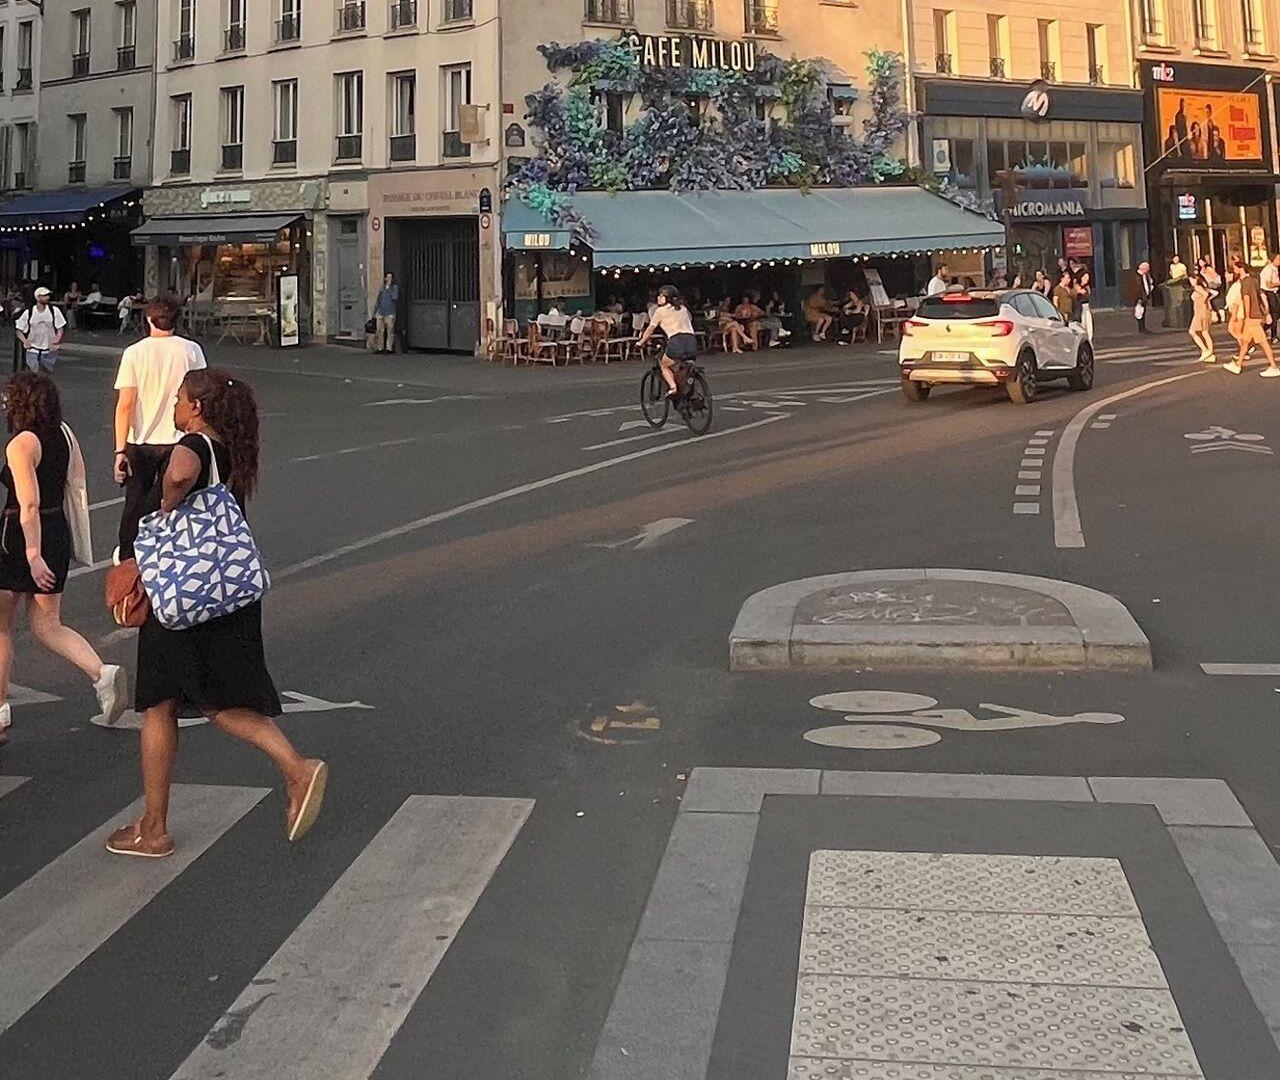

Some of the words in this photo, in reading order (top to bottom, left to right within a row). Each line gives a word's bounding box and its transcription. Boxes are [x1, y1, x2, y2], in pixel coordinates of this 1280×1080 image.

[628, 34, 681, 68] CAFE
[691, 39, 755, 72] MILOU
[810, 242, 840, 256] MILOU
